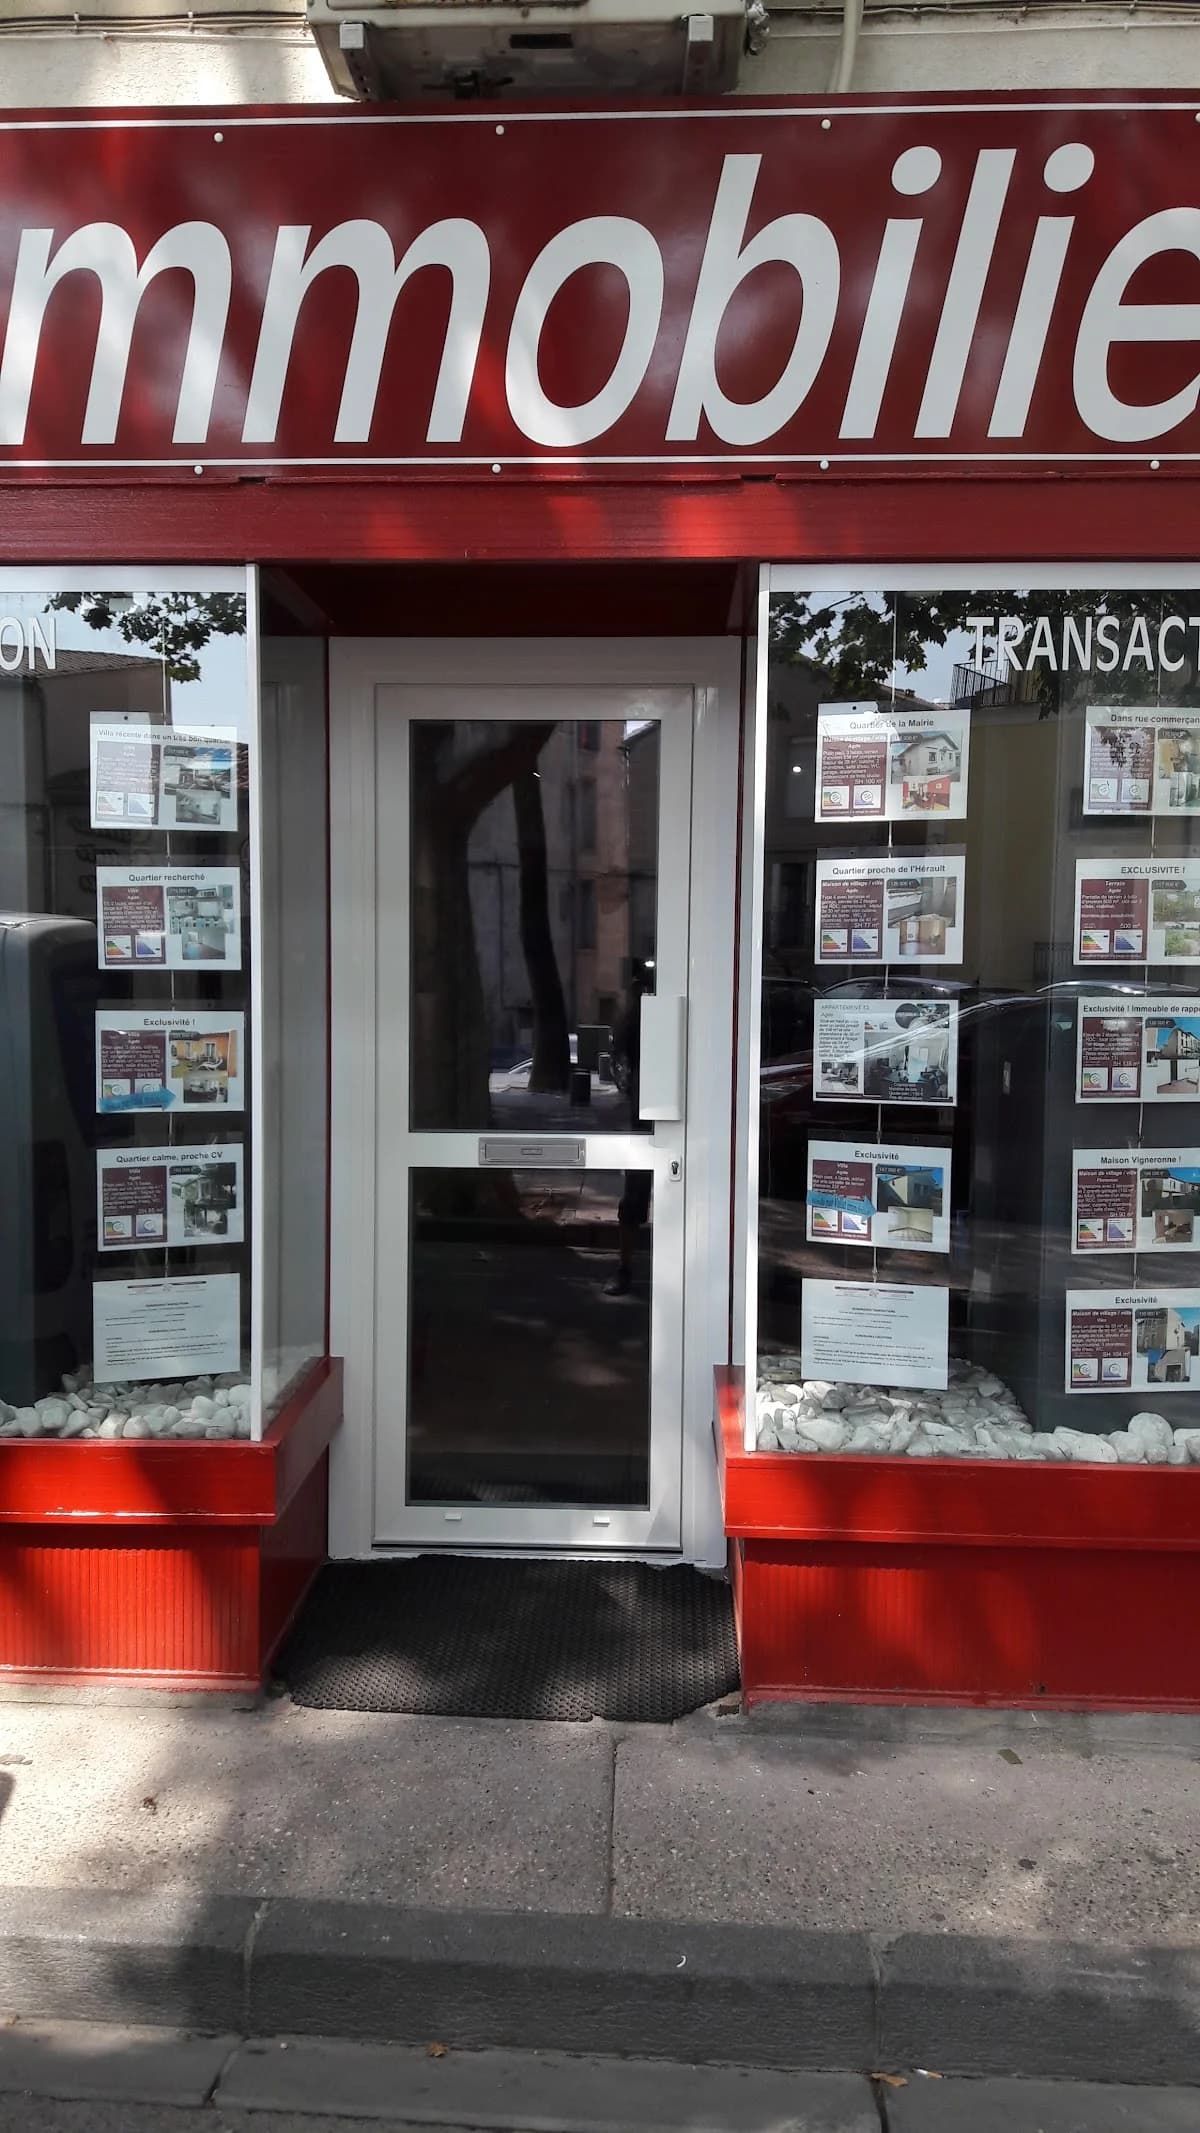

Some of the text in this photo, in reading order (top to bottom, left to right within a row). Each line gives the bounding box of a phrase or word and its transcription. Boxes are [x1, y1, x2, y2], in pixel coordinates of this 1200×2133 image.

[0, 142, 1200, 446] mmobilie
[0, 616, 56, 670] ON
[908, 718, 935, 727] Mairie
[1111, 714, 1133, 722] Dans
[1135, 715, 1149, 723] rue
[832, 864, 946, 875] Quartier proche de l'Hérault
[1120, 866, 1180, 874] EXCLUSIVITE
[128, 873, 206, 882] Quartier recherché
[1083, 1004, 1125, 1013] Exclusivité
[1131, 1004, 1169, 1012] Immeuble
[1181, 1006, 1200, 1014] rapp
[143, 1018, 191, 1026] Exclusivité
[116, 1154, 150, 1163] Quartier
[180, 1152, 209, 1161] proche
[211, 1151, 223, 1159] CV
[854, 1150, 900, 1161] Exclusivité
[1131, 1156, 1177, 1165] Vigneronne
[1115, 1296, 1158, 1304] Exclusivité
